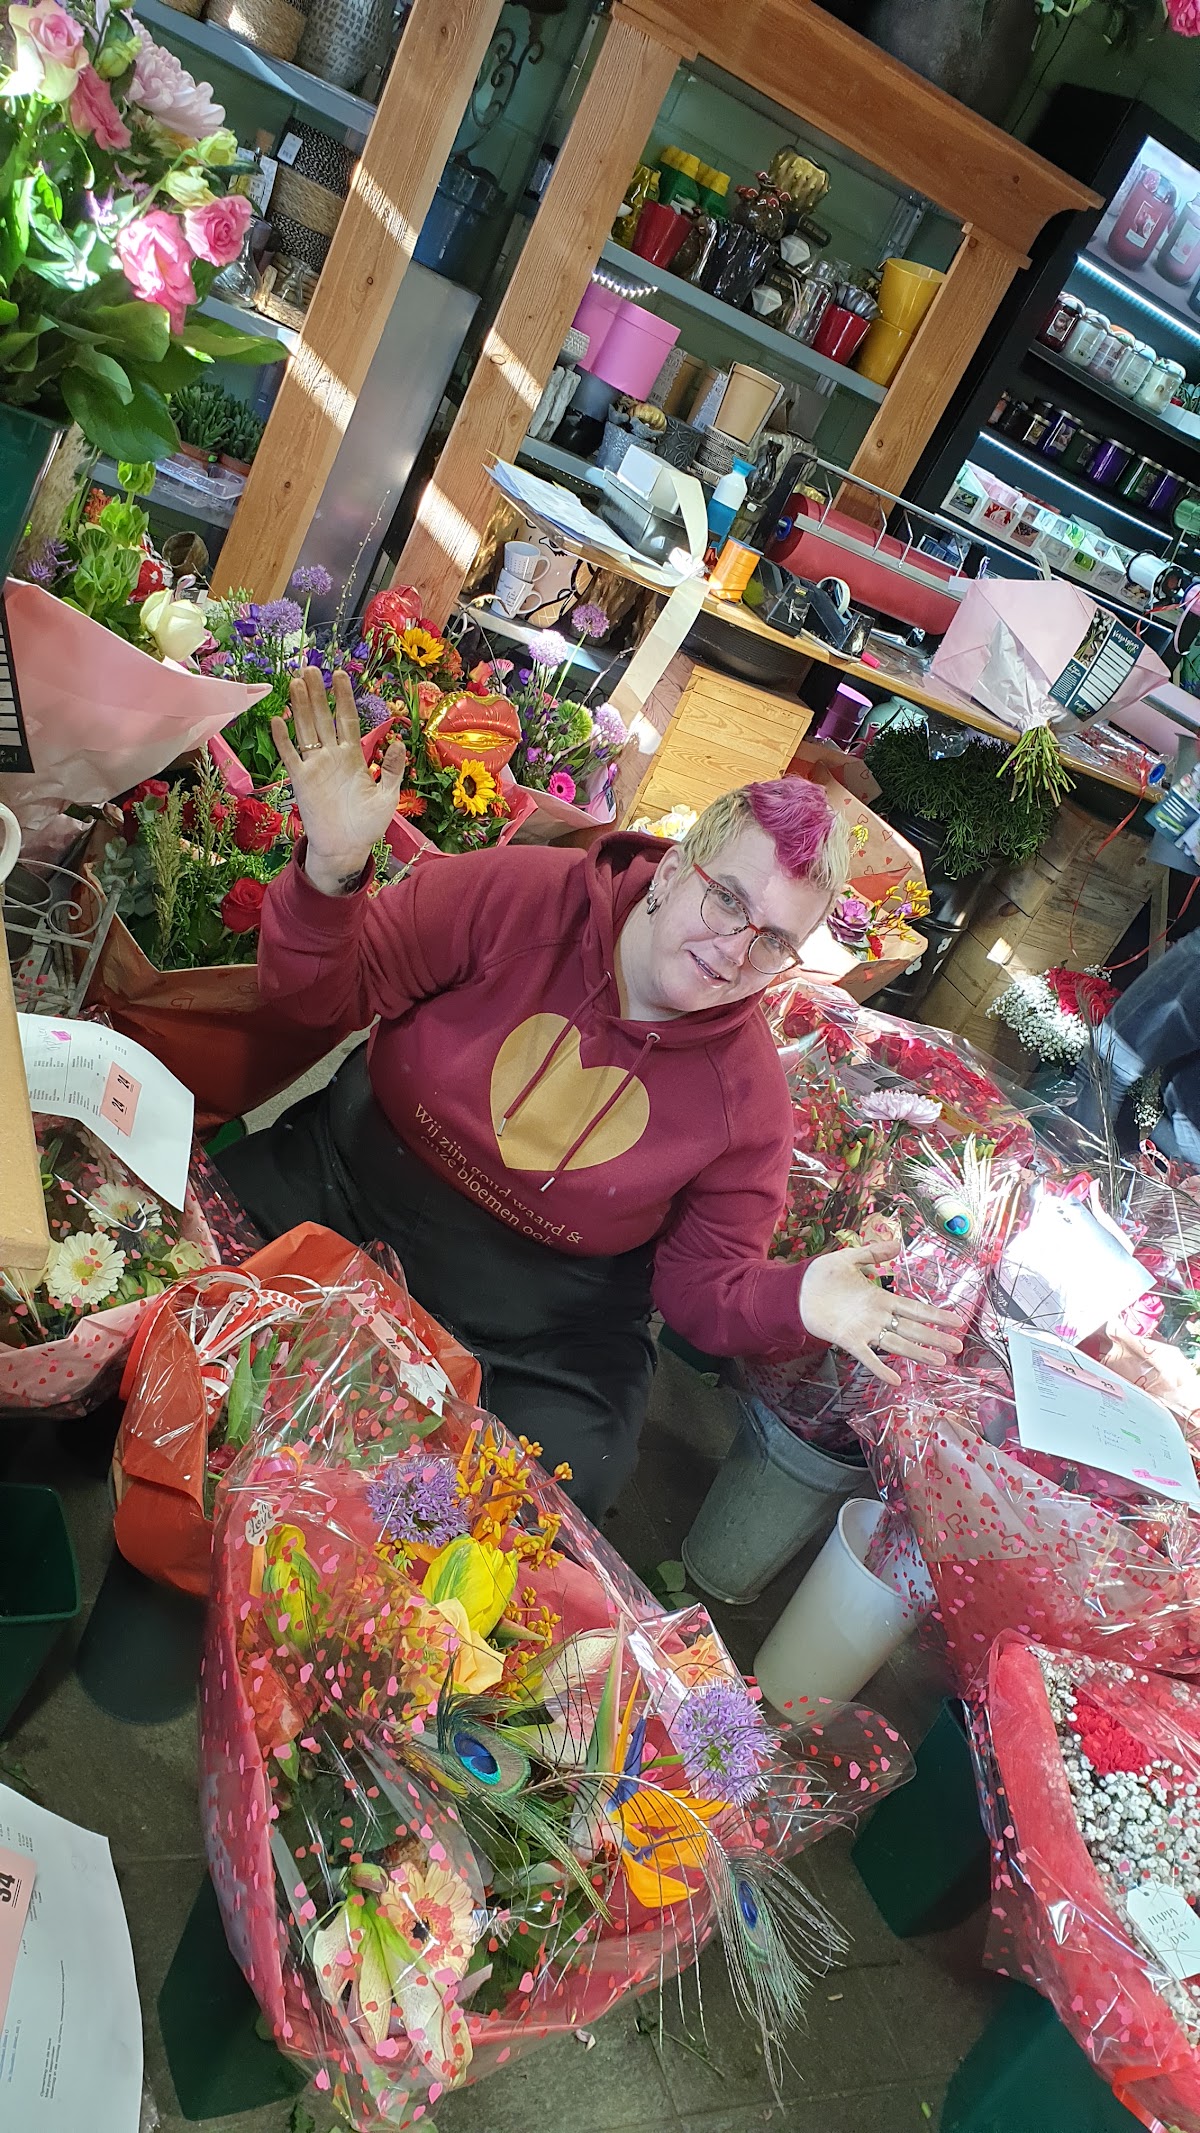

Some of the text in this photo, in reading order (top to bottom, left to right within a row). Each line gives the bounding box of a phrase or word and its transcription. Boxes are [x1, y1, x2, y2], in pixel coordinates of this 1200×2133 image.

[415, 1103, 442, 1138] Wij
[439, 1136, 468, 1165] zijn
[513, 1198, 566, 1237] waard
[566, 1231, 584, 1244] &
[456, 1166, 520, 1227] bloemen
[522, 1225, 554, 1246] ook
[1147, 1907, 1179, 1926] HAPPY
[1169, 1931, 1190, 1945] DAY
